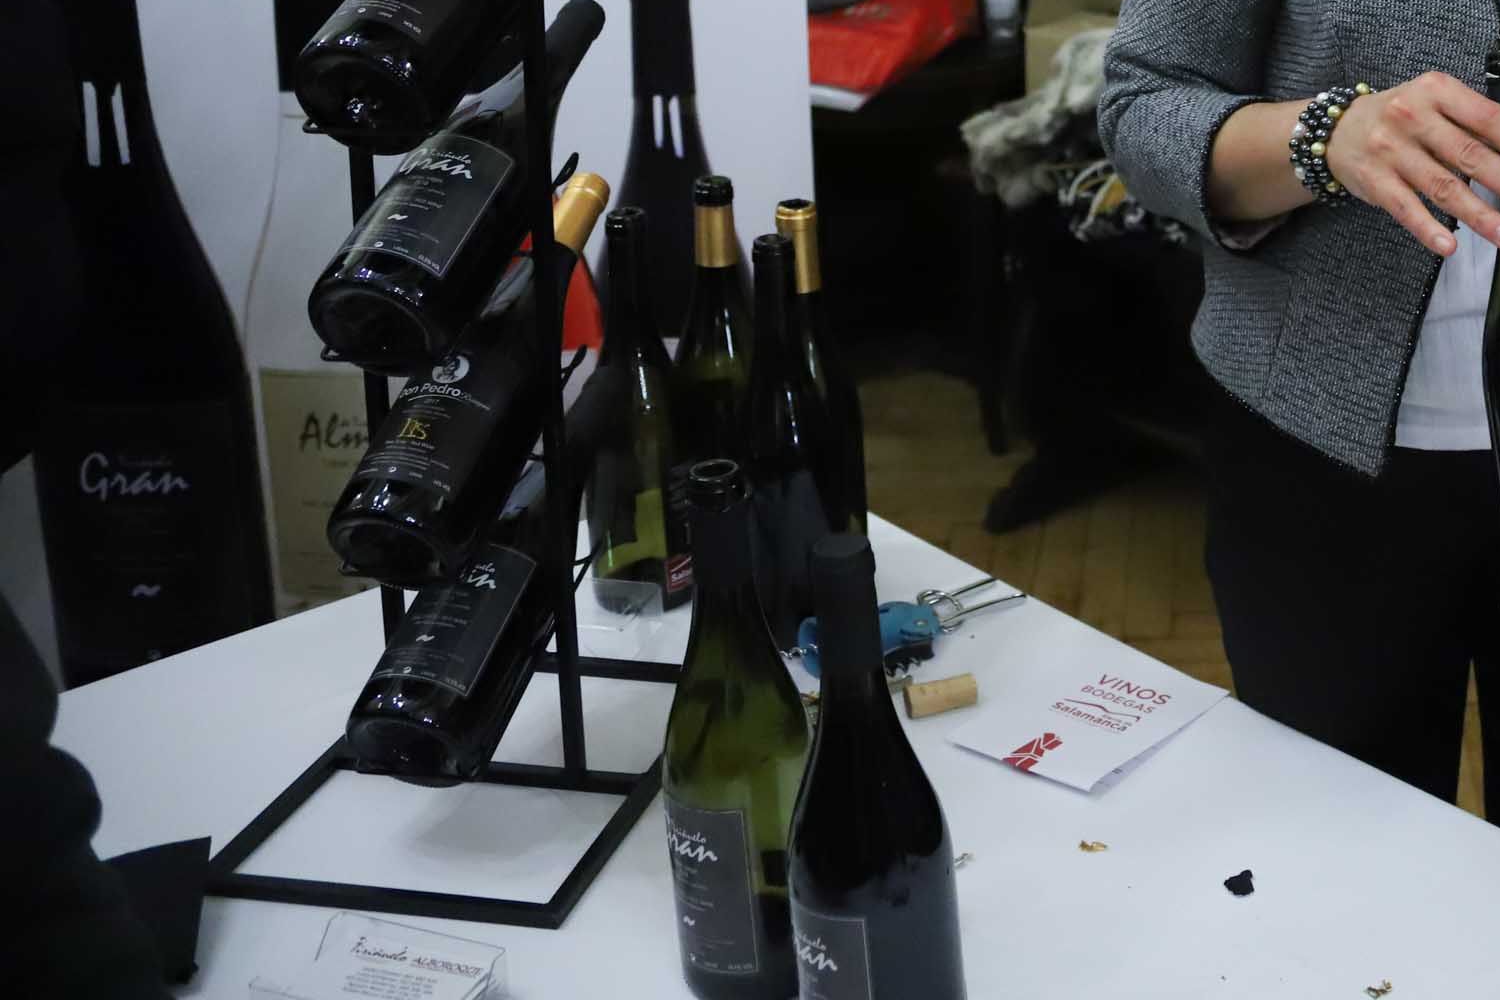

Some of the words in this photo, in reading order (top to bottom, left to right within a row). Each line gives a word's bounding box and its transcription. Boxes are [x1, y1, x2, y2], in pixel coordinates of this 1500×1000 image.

[420, 382, 461, 397] Pedro
[299, 411, 369, 452] Alm
[80, 452, 190, 501] Gran
[1080, 684, 1157, 714] BODEGAS
[1098, 674, 1172, 705] VINOS
[1052, 701, 1128, 732] Salamanca
